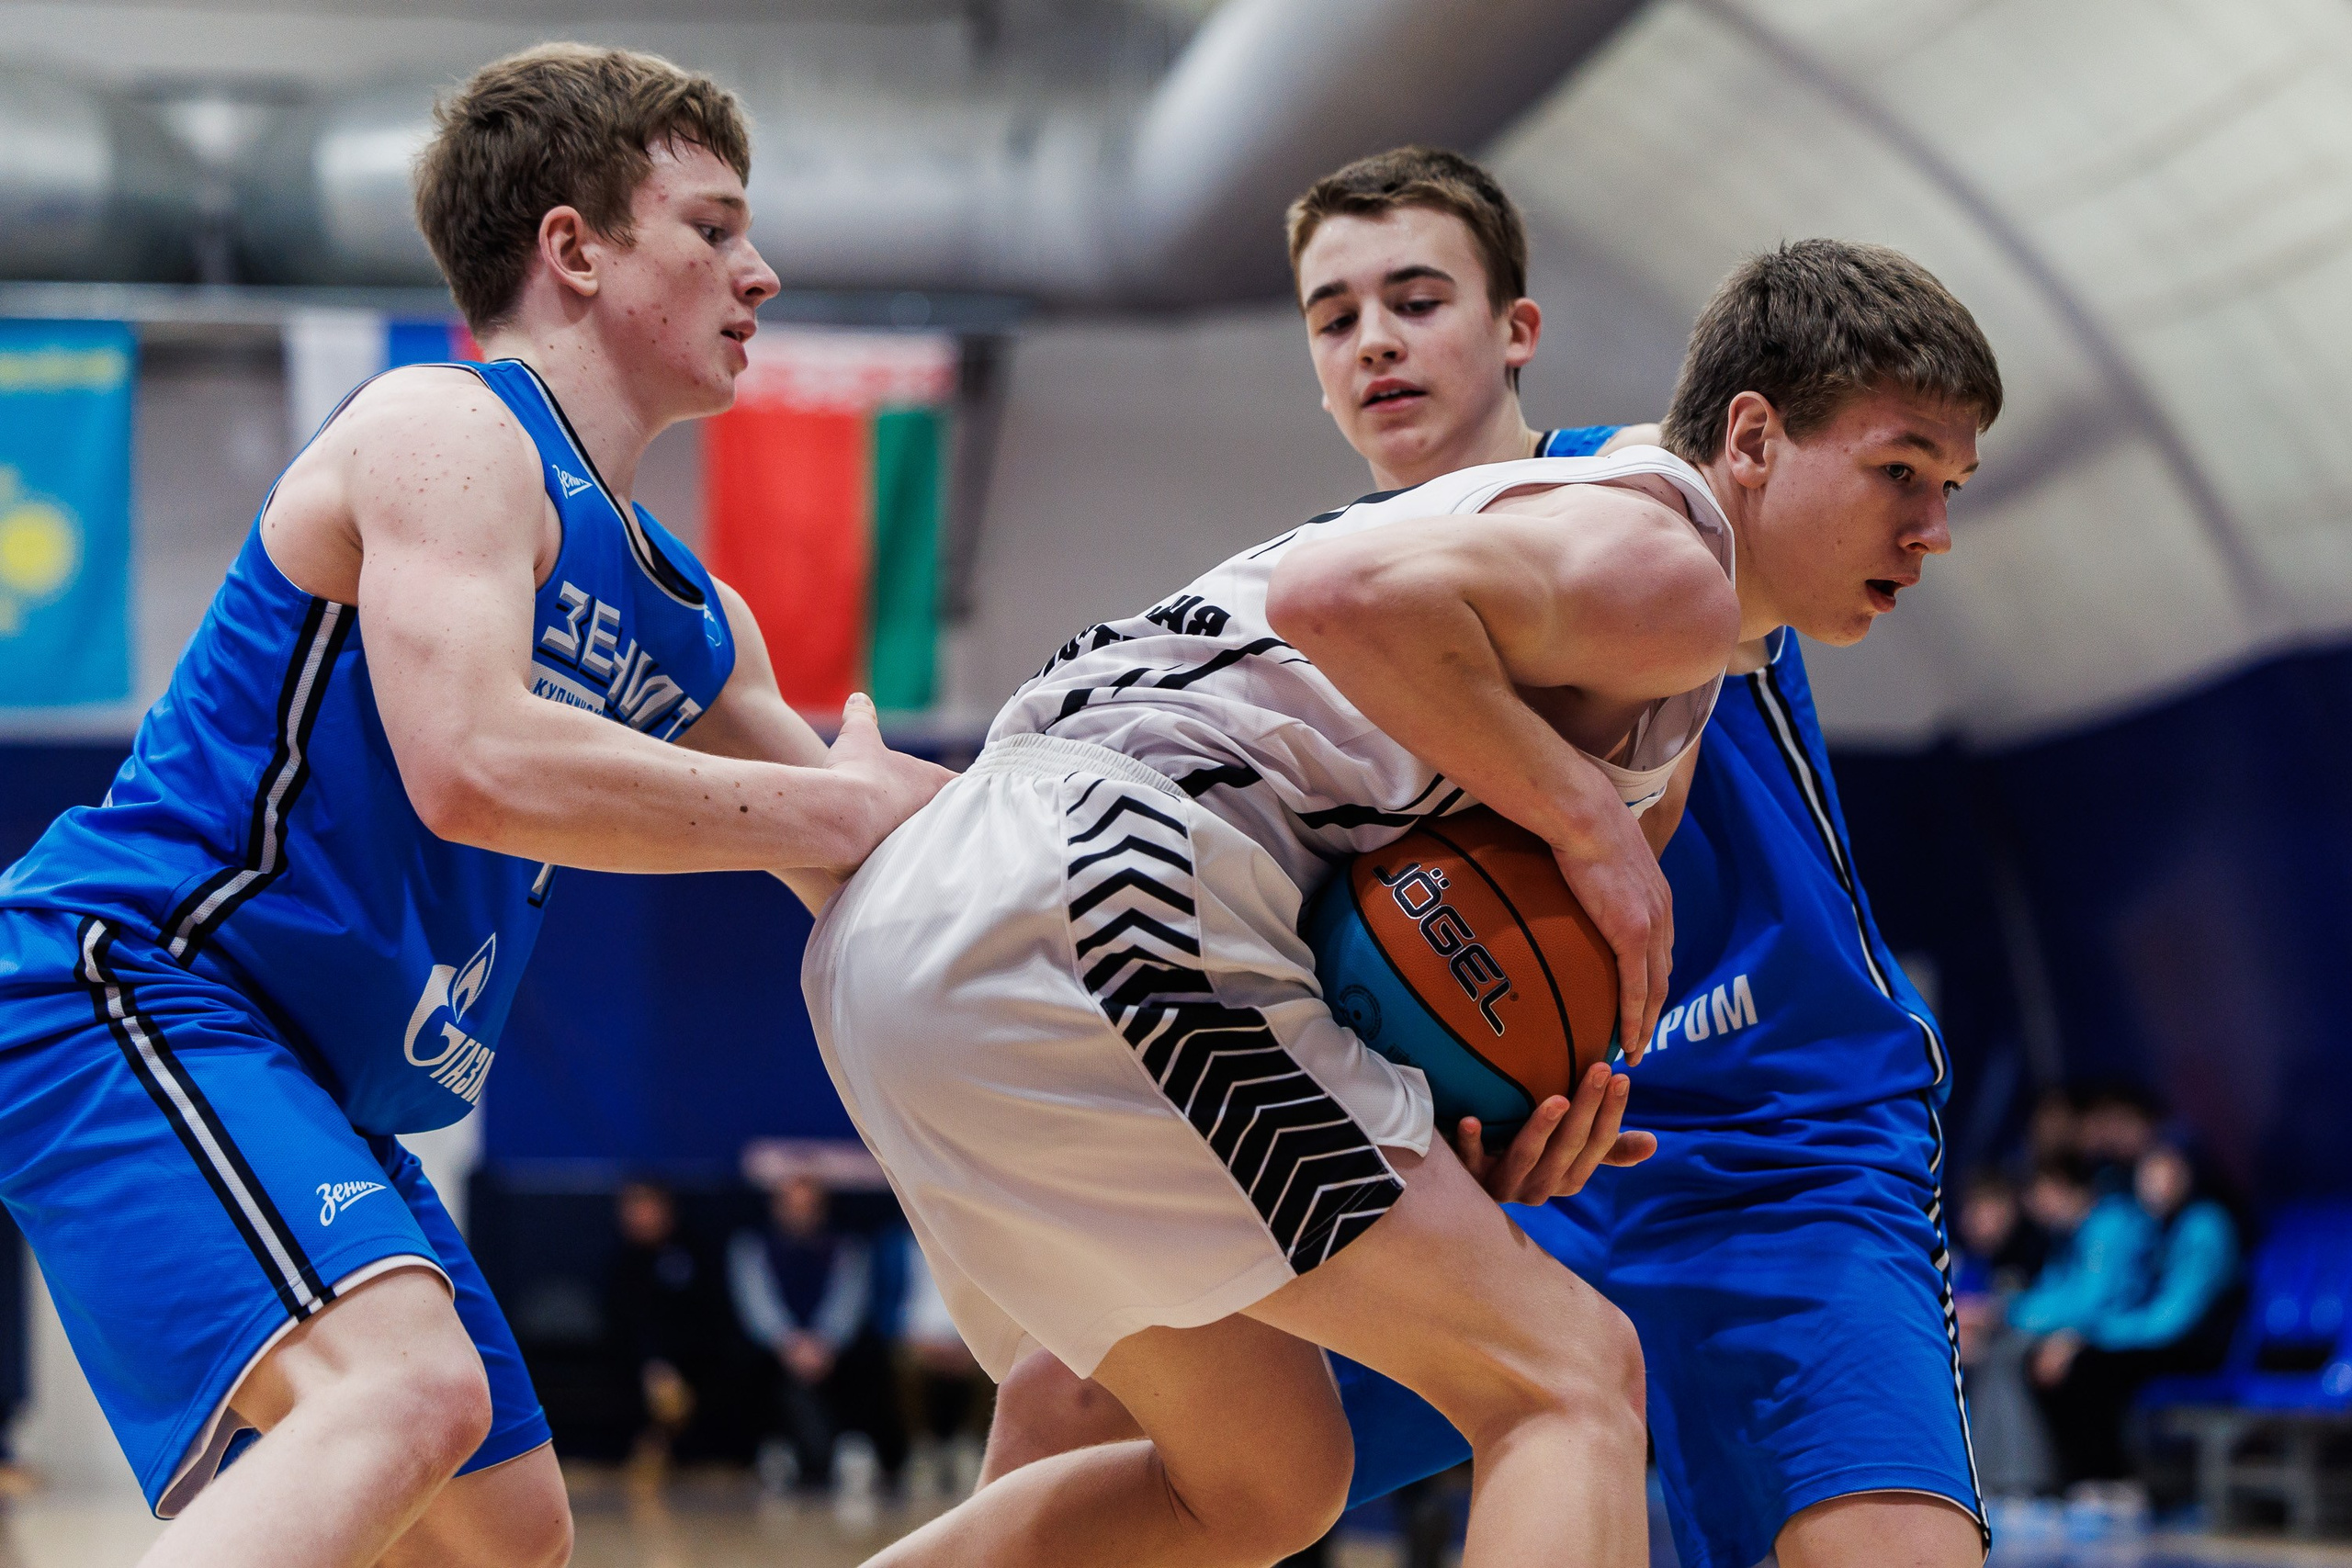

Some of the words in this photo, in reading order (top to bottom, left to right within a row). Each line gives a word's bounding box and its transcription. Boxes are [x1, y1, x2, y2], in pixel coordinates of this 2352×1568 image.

[540, 581, 703, 742] ЗЕНИТ
[1372, 862, 1512, 1037] JÖGEL
[429, 1037, 495, 1106] ГАЗП
[1643, 974, 1758, 1055] РОМ
